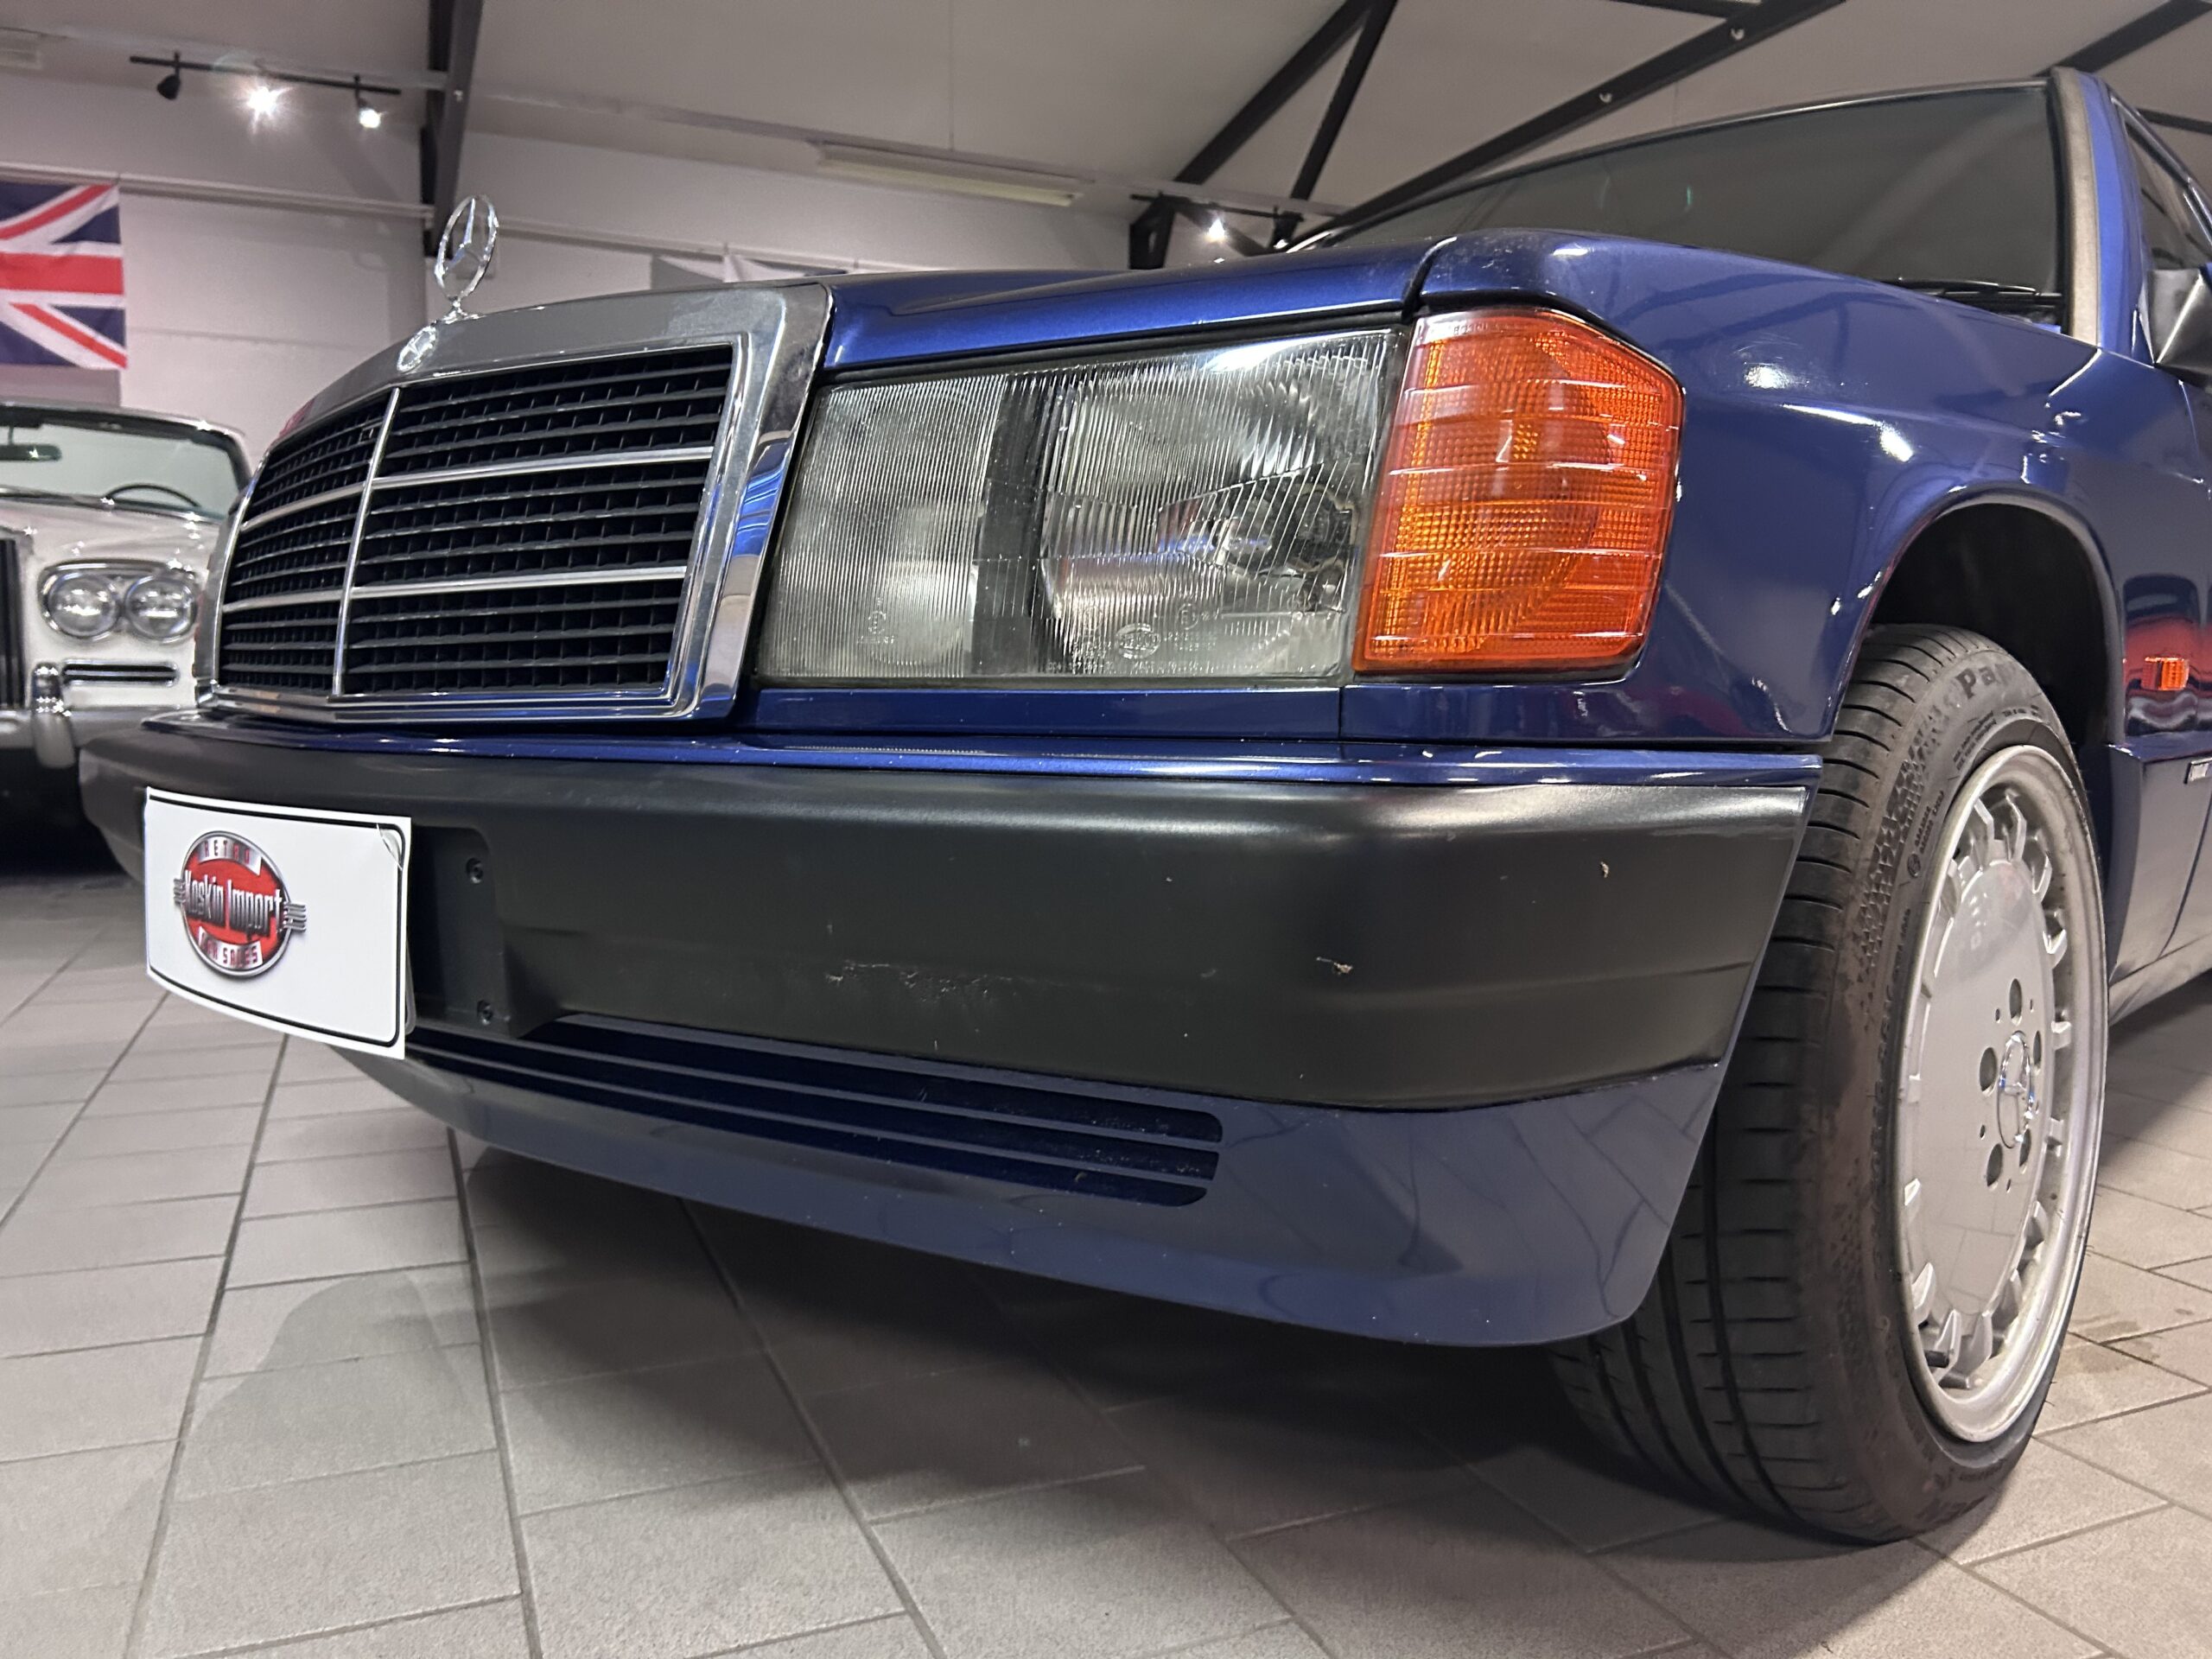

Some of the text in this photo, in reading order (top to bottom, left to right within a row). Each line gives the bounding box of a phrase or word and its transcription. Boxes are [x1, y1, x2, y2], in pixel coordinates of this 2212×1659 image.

[204, 839, 251, 864] RETRO
[227, 879, 282, 936] Import
[222, 944, 258, 968] SALES
